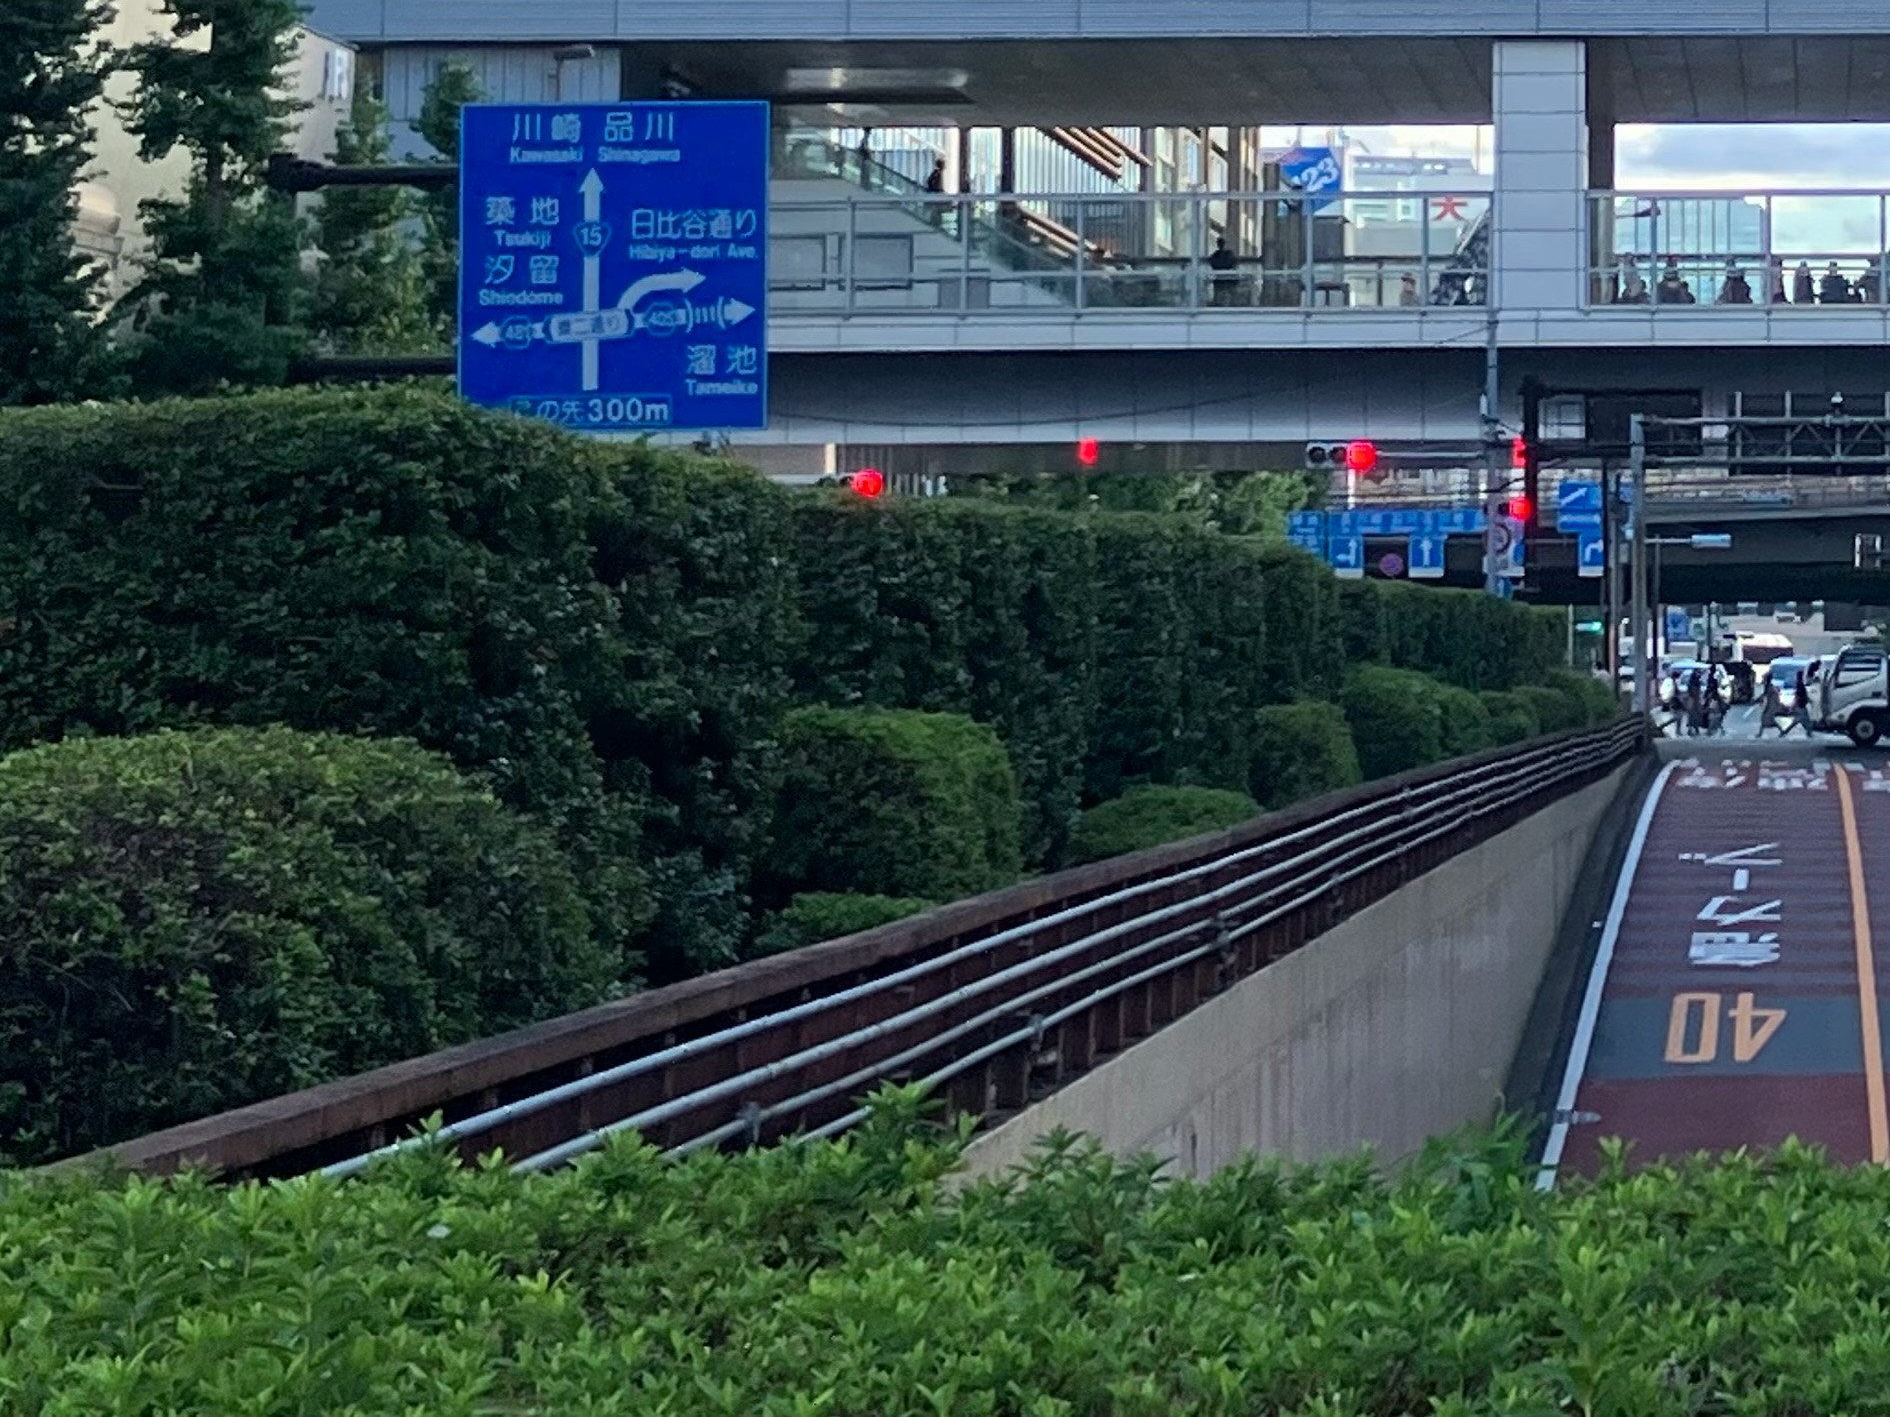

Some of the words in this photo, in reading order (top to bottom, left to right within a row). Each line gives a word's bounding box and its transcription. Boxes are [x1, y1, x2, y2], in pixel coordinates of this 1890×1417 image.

[512, 112, 582, 143] 川崎
[604, 112, 674, 142] 品川
[509, 146, 584, 163] Kawasaki
[597, 146, 681, 165] Shinagawa
[485, 196, 560, 225] 築地
[631, 207, 757, 240] 日比谷通り
[493, 229, 552, 250] Tsukiji
[580, 225, 602, 246] 15
[485, 255, 560, 284] 汐留
[478, 288, 564, 306] Shiodome
[686, 344, 758, 375] 溜池
[685, 379, 759, 395] Tameike
[1665, 991, 1788, 1064] 40
